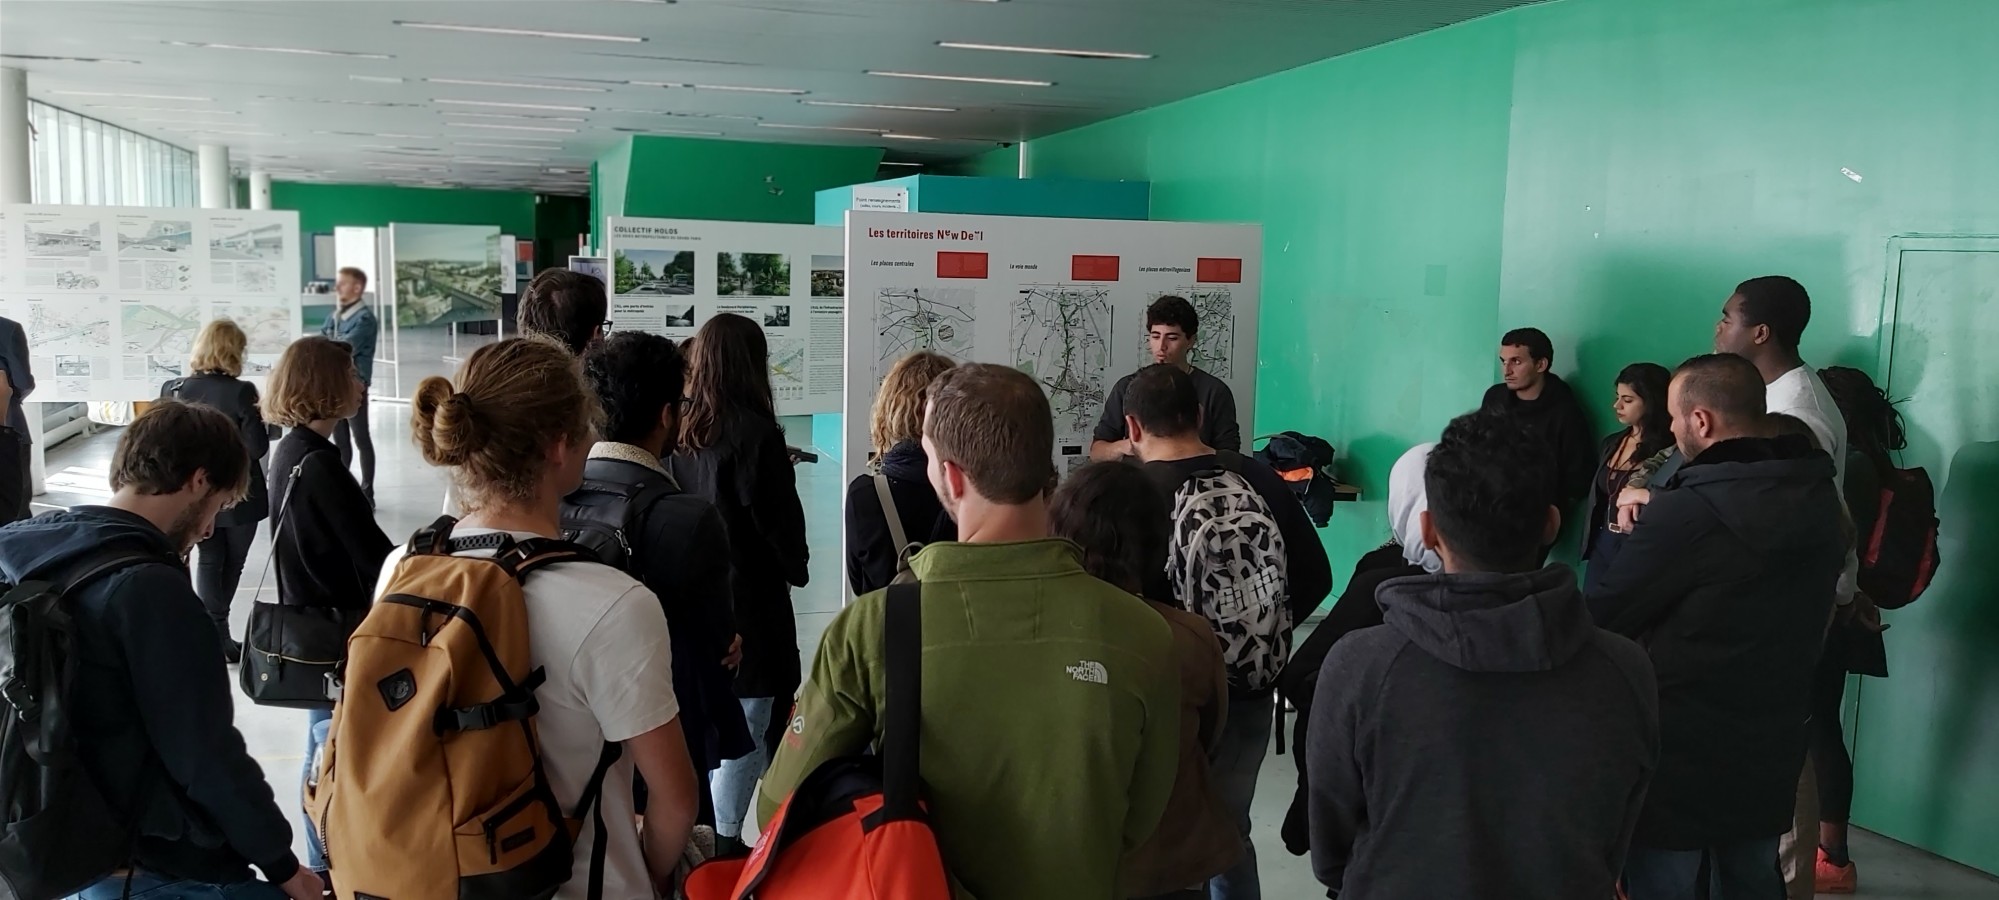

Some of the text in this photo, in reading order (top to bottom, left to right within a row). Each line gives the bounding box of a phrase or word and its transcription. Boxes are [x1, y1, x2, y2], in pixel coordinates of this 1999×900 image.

[614, 226, 652, 234] COLLECTIF
[869, 228, 884, 238] Les
[887, 229, 934, 240] territoires
[1080, 660, 1095, 669] THE
[1066, 665, 1096, 676] NORTH
[1072, 672, 1095, 682] FACE
